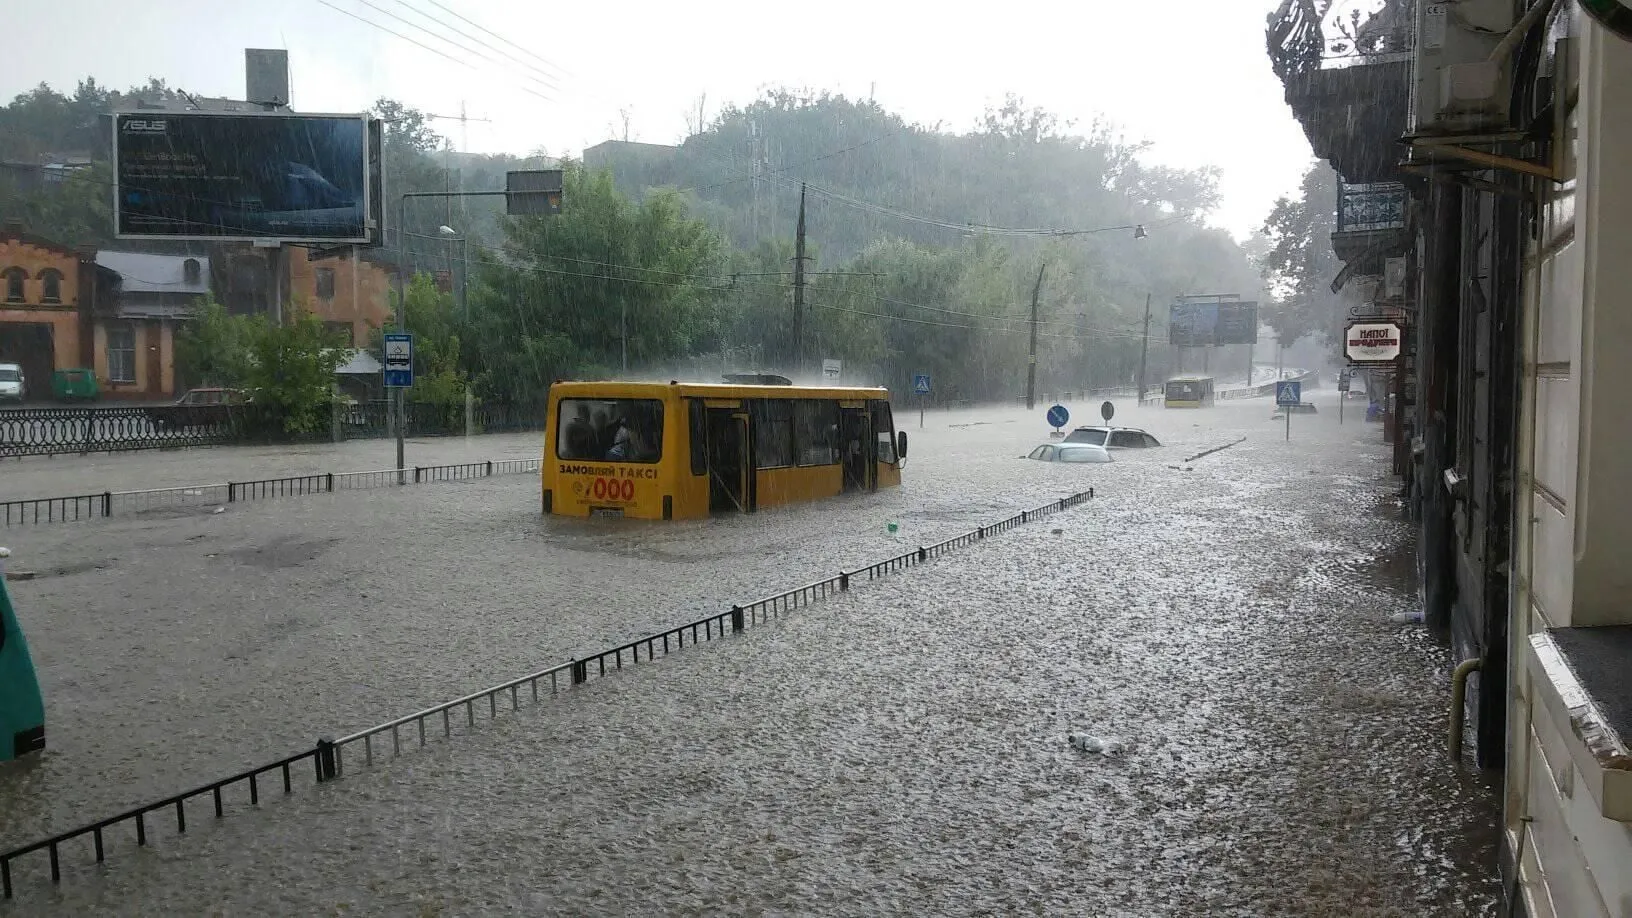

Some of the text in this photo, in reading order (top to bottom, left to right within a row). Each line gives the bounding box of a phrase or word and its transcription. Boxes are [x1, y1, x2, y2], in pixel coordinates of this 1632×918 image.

[122, 120, 167, 130] ASUS
[559, 464, 658, 480] ЗАМОВЛЯЙ ТАКСІ
